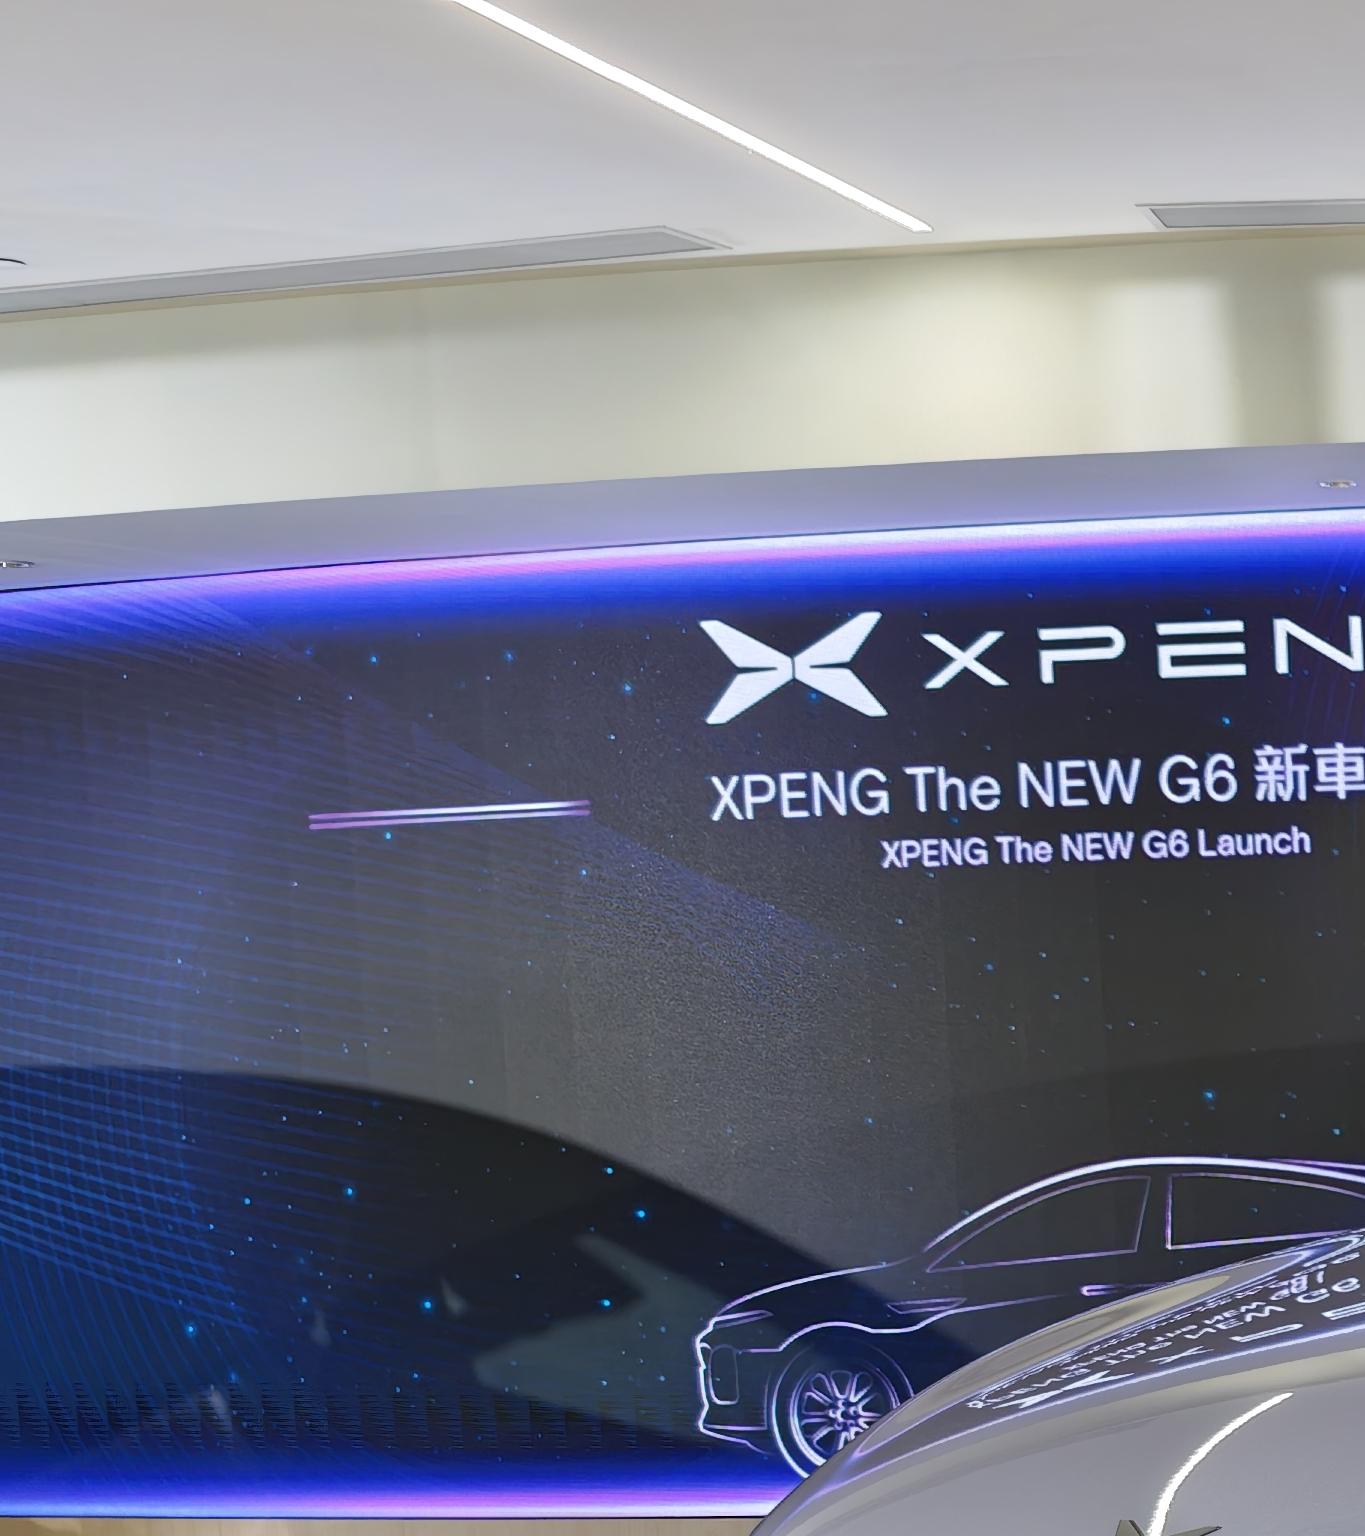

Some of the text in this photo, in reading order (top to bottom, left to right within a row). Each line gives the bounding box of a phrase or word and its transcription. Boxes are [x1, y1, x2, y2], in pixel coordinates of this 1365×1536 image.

[710, 767, 890, 823] XPENG
[903, 765, 1002, 814] The
[1018, 757, 1142, 809] NEW
[1158, 752, 1239, 805] G6
[880, 824, 1312, 870] XPENG The NEW G6 Launch
